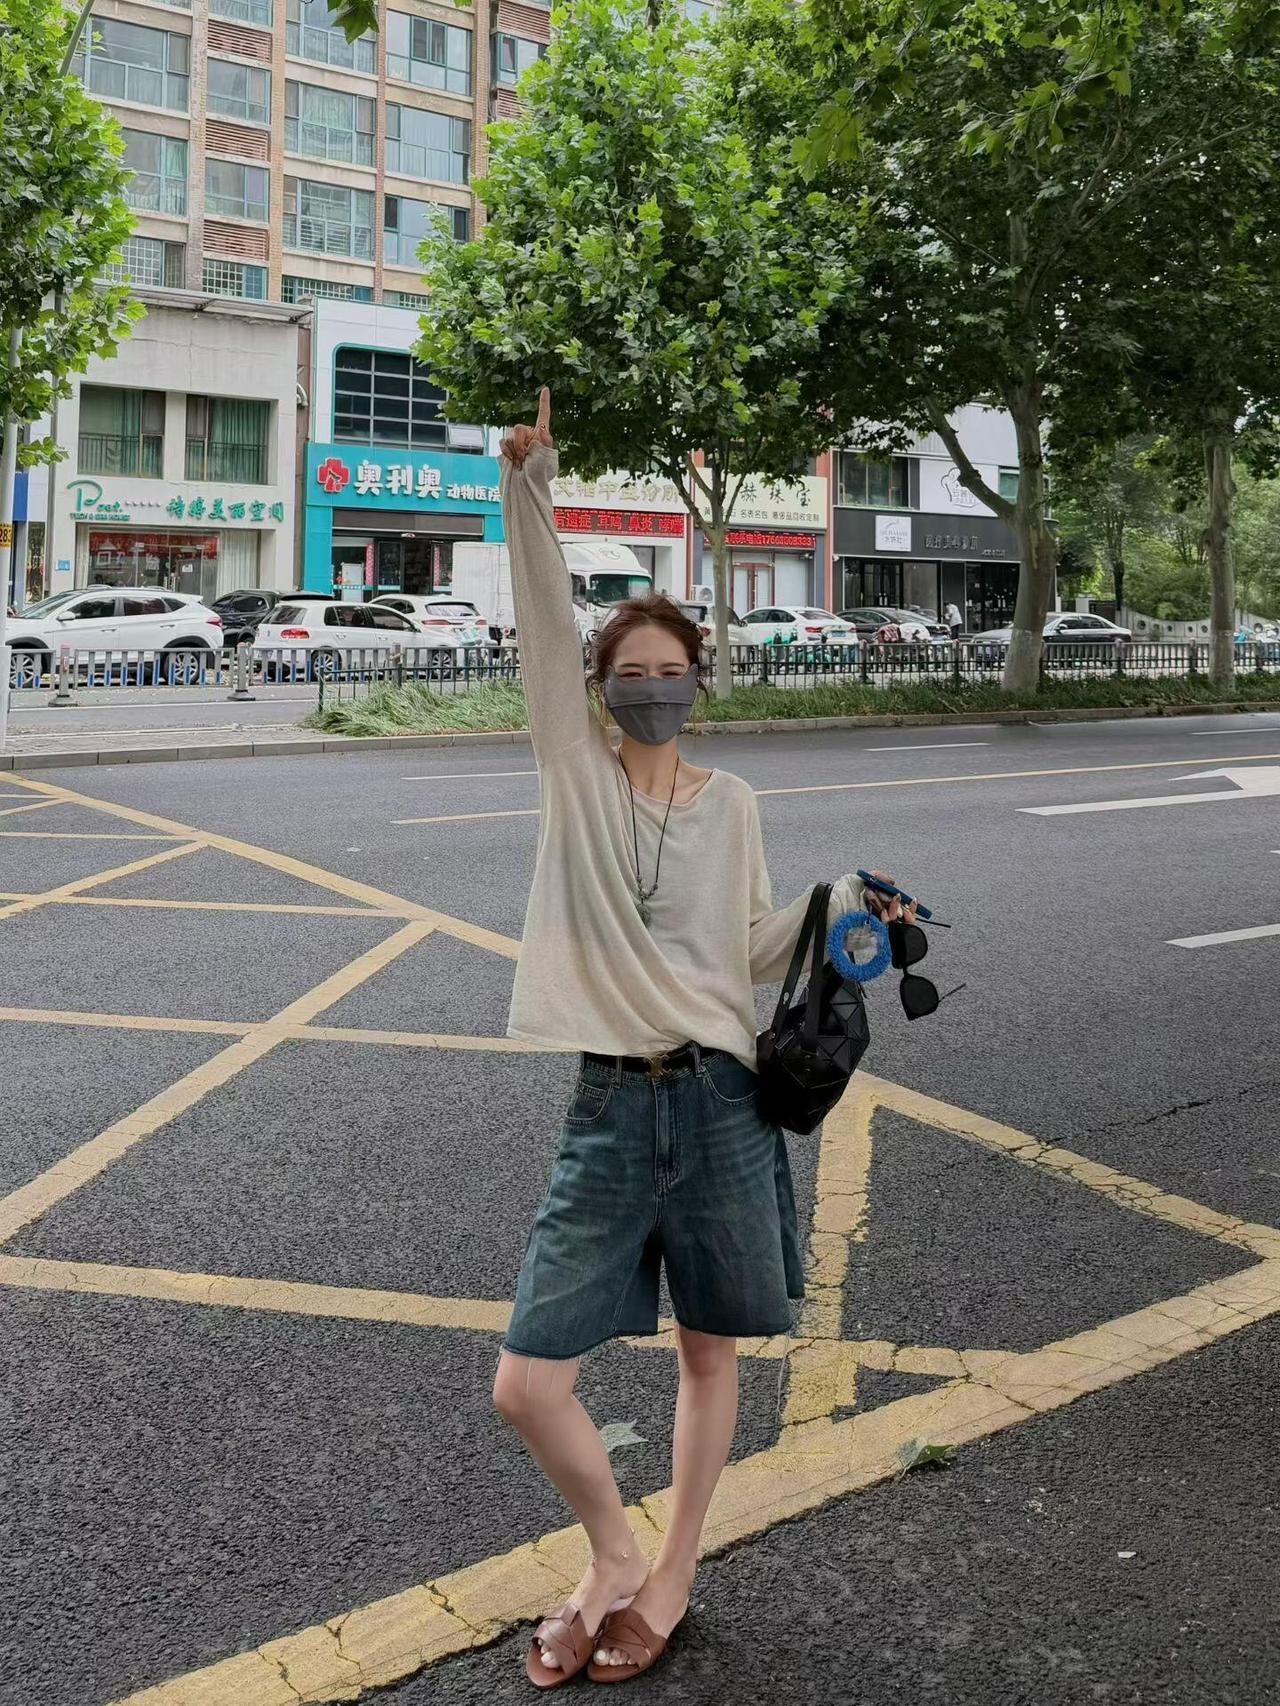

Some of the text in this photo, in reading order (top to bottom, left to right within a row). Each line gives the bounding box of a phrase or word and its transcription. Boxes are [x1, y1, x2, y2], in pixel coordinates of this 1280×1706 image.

[354, 459, 443, 499] 奥利奥
[597, 513, 623, 532] 耳鸣
